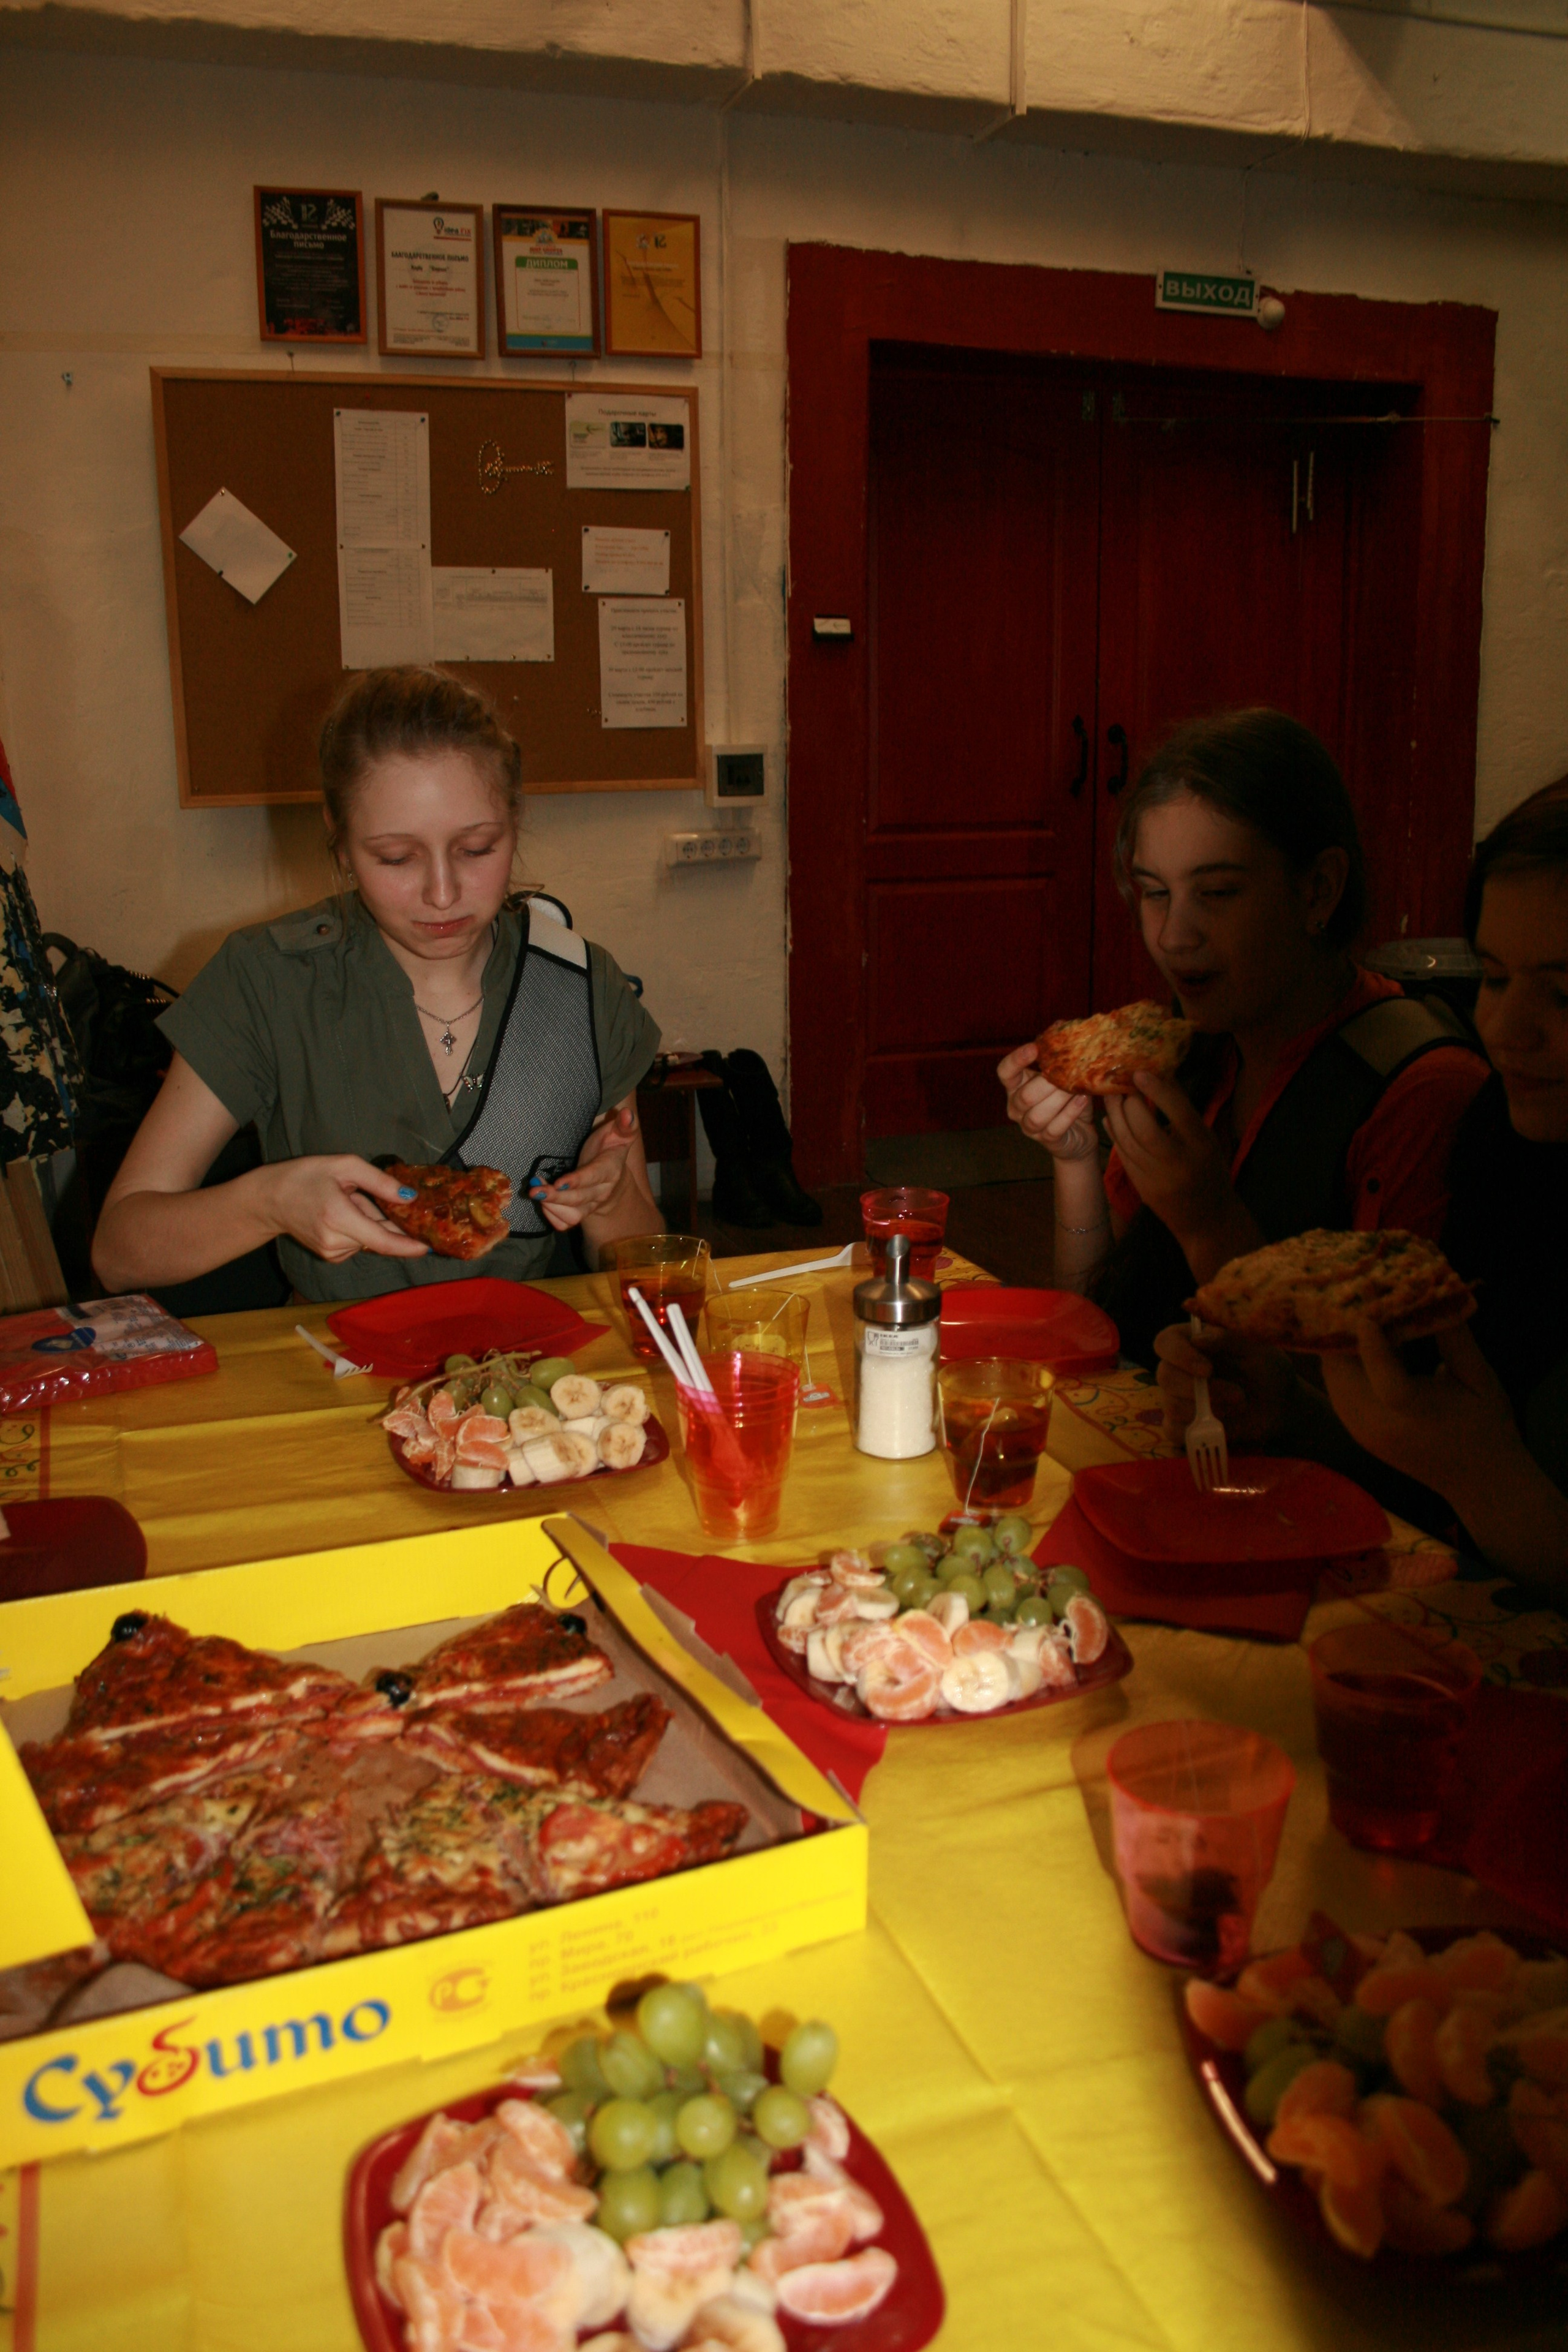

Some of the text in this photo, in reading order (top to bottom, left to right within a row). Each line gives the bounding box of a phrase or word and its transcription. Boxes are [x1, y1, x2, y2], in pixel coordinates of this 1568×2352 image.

[270, 230, 347, 242] Благодарственное
[293, 241, 325, 250] письмо
[391, 251, 446, 261] БЛАГОДАРСТВЕННОЕ
[526, 258, 568, 269] ДИПЛОМ
[1166, 280, 1251, 307] ВЫХОД
[598, 409, 637, 417] Подарочные
